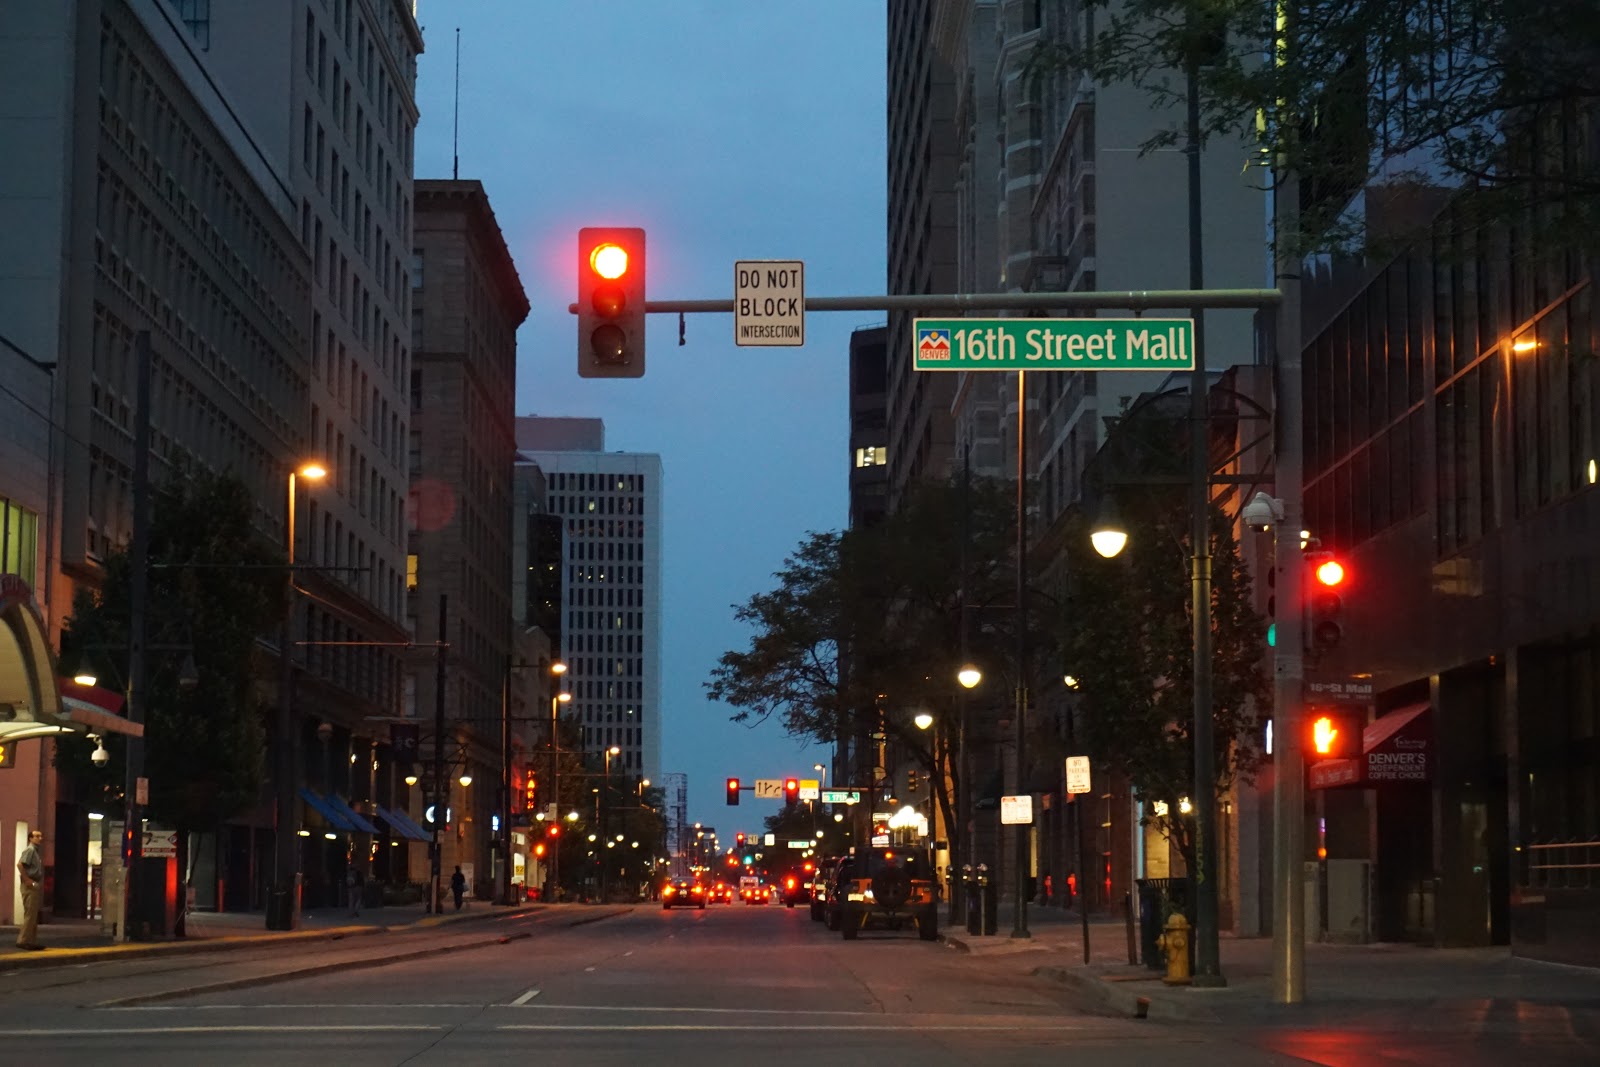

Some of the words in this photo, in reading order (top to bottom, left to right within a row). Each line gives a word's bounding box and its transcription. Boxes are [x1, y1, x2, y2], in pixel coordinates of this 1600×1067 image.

[740, 270, 760, 289] DO
[767, 270, 798, 289] NOT
[740, 298, 798, 317] BLOCK
[740, 325, 800, 338] INTERSECTION
[954, 327, 1016, 361] 16th
[1025, 328, 1117, 361] Street
[1126, 327, 1188, 361] Mall
[920, 349, 950, 360] DENVER
[1346, 684, 1372, 694] Mall
[1368, 753, 1426, 764] DENVER'S
[1368, 764, 1425, 772] INDEPENDENT
[1368, 772, 1397, 780] COFFEE
[1399, 772, 1425, 780] CHOICE
